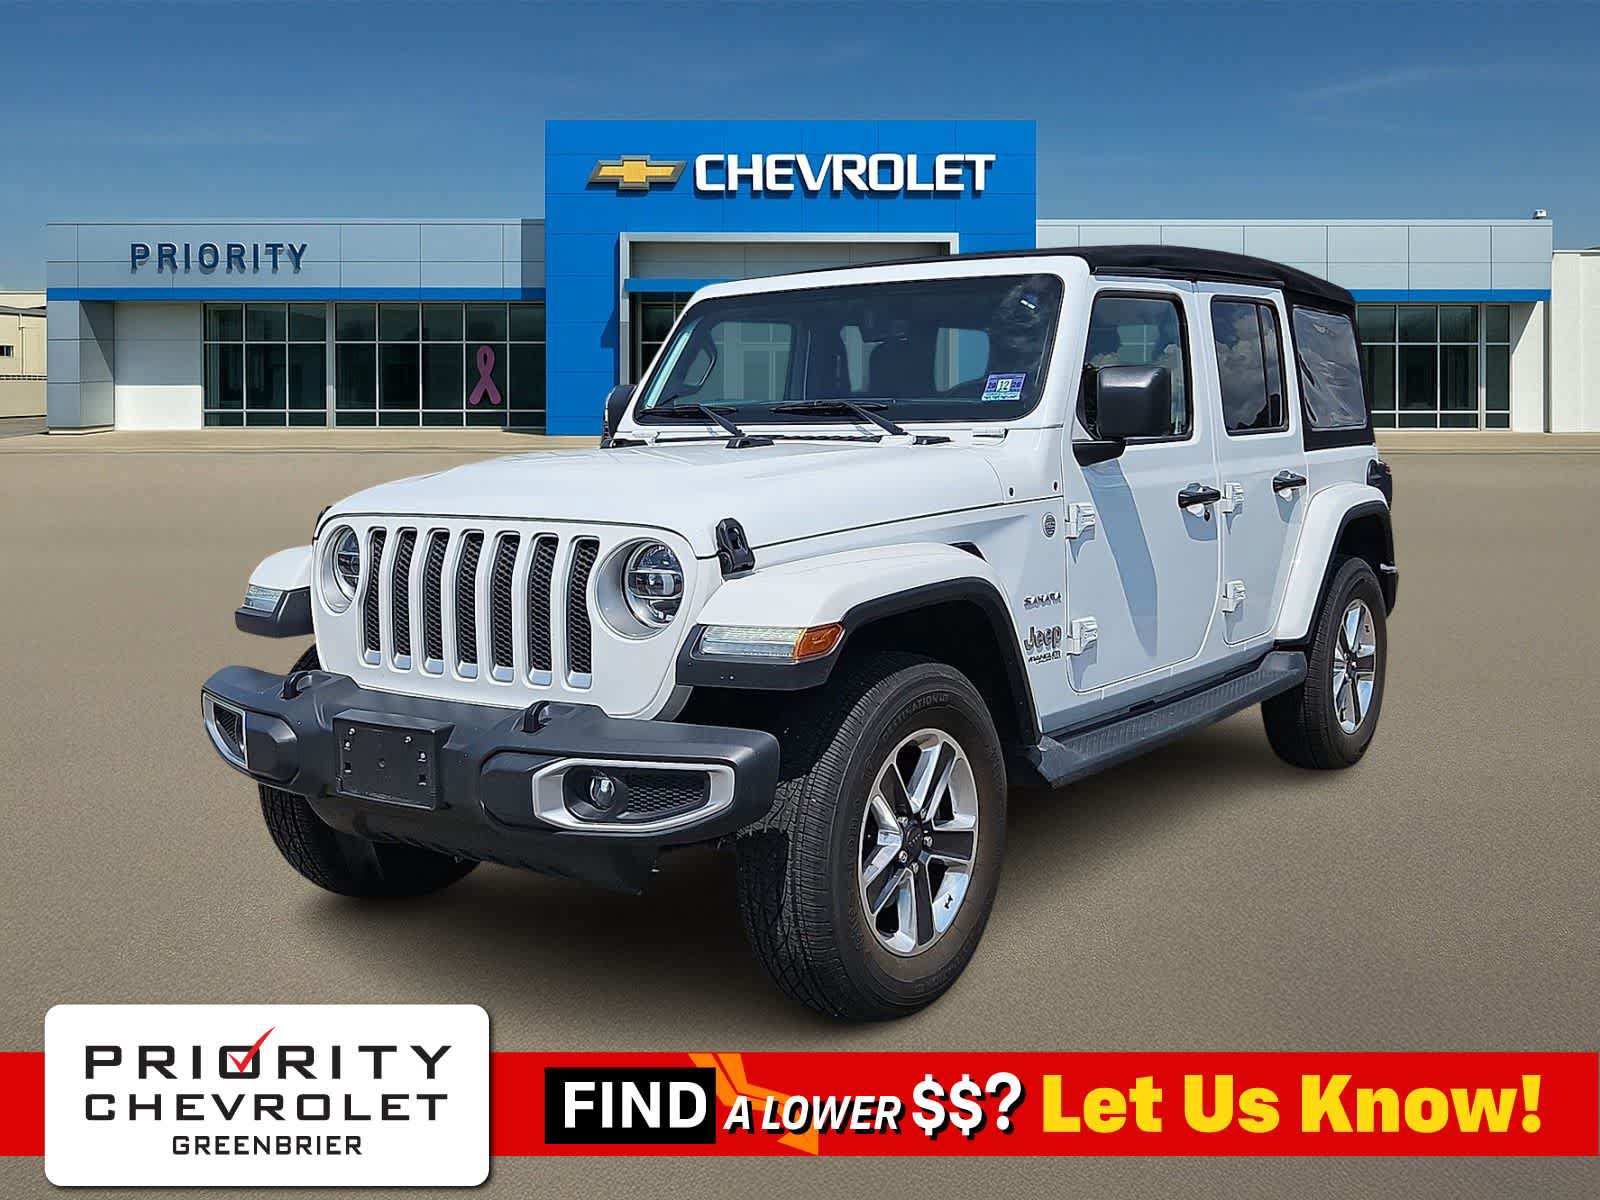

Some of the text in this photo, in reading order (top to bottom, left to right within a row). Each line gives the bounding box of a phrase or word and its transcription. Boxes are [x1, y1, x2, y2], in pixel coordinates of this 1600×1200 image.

[694, 153, 996, 192] CHEVROLET
[130, 242, 308, 273] PRIORITY
[999, 380, 1010, 391] 12
[1024, 592, 1061, 607] SAHARA
[1023, 626, 1062, 650] Jeep
